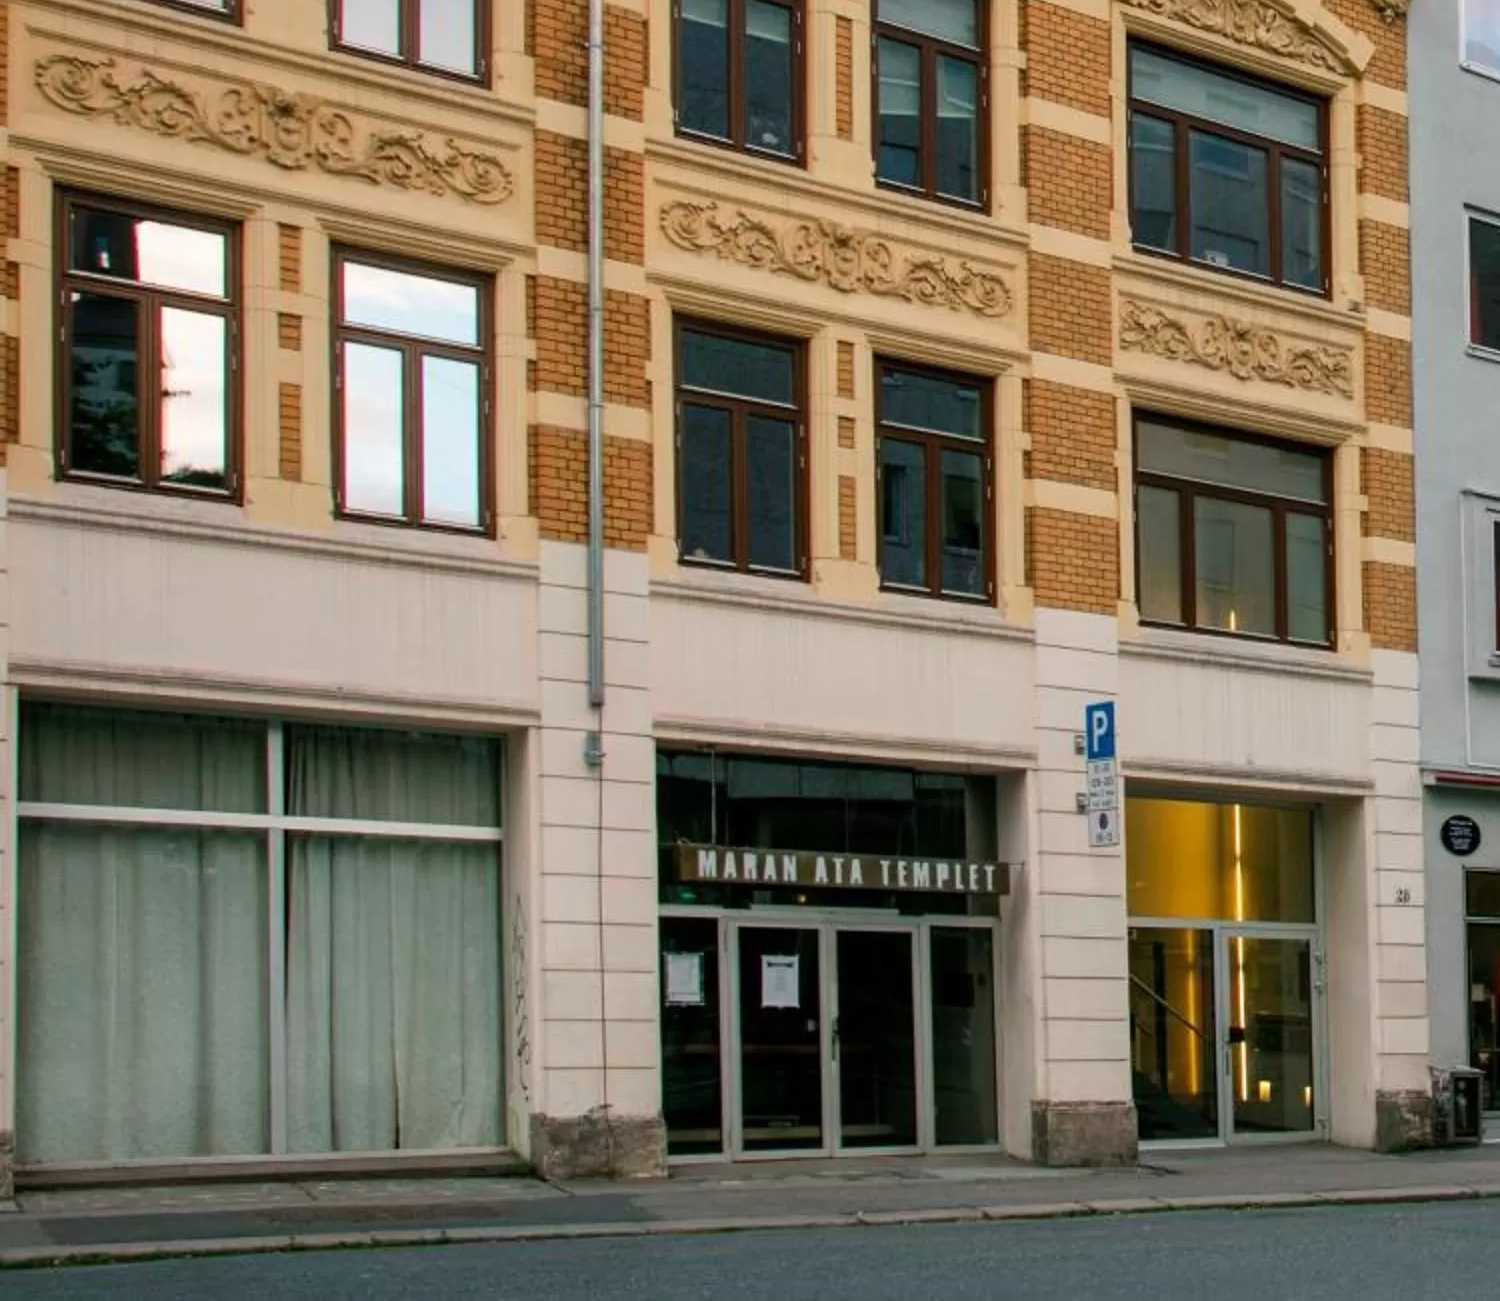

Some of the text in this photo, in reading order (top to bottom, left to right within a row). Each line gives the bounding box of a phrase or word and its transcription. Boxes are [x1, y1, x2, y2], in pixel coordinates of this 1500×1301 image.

[1091, 709, 1109, 752] P
[697, 849, 997, 892] MARAN ATA TEMPLET
